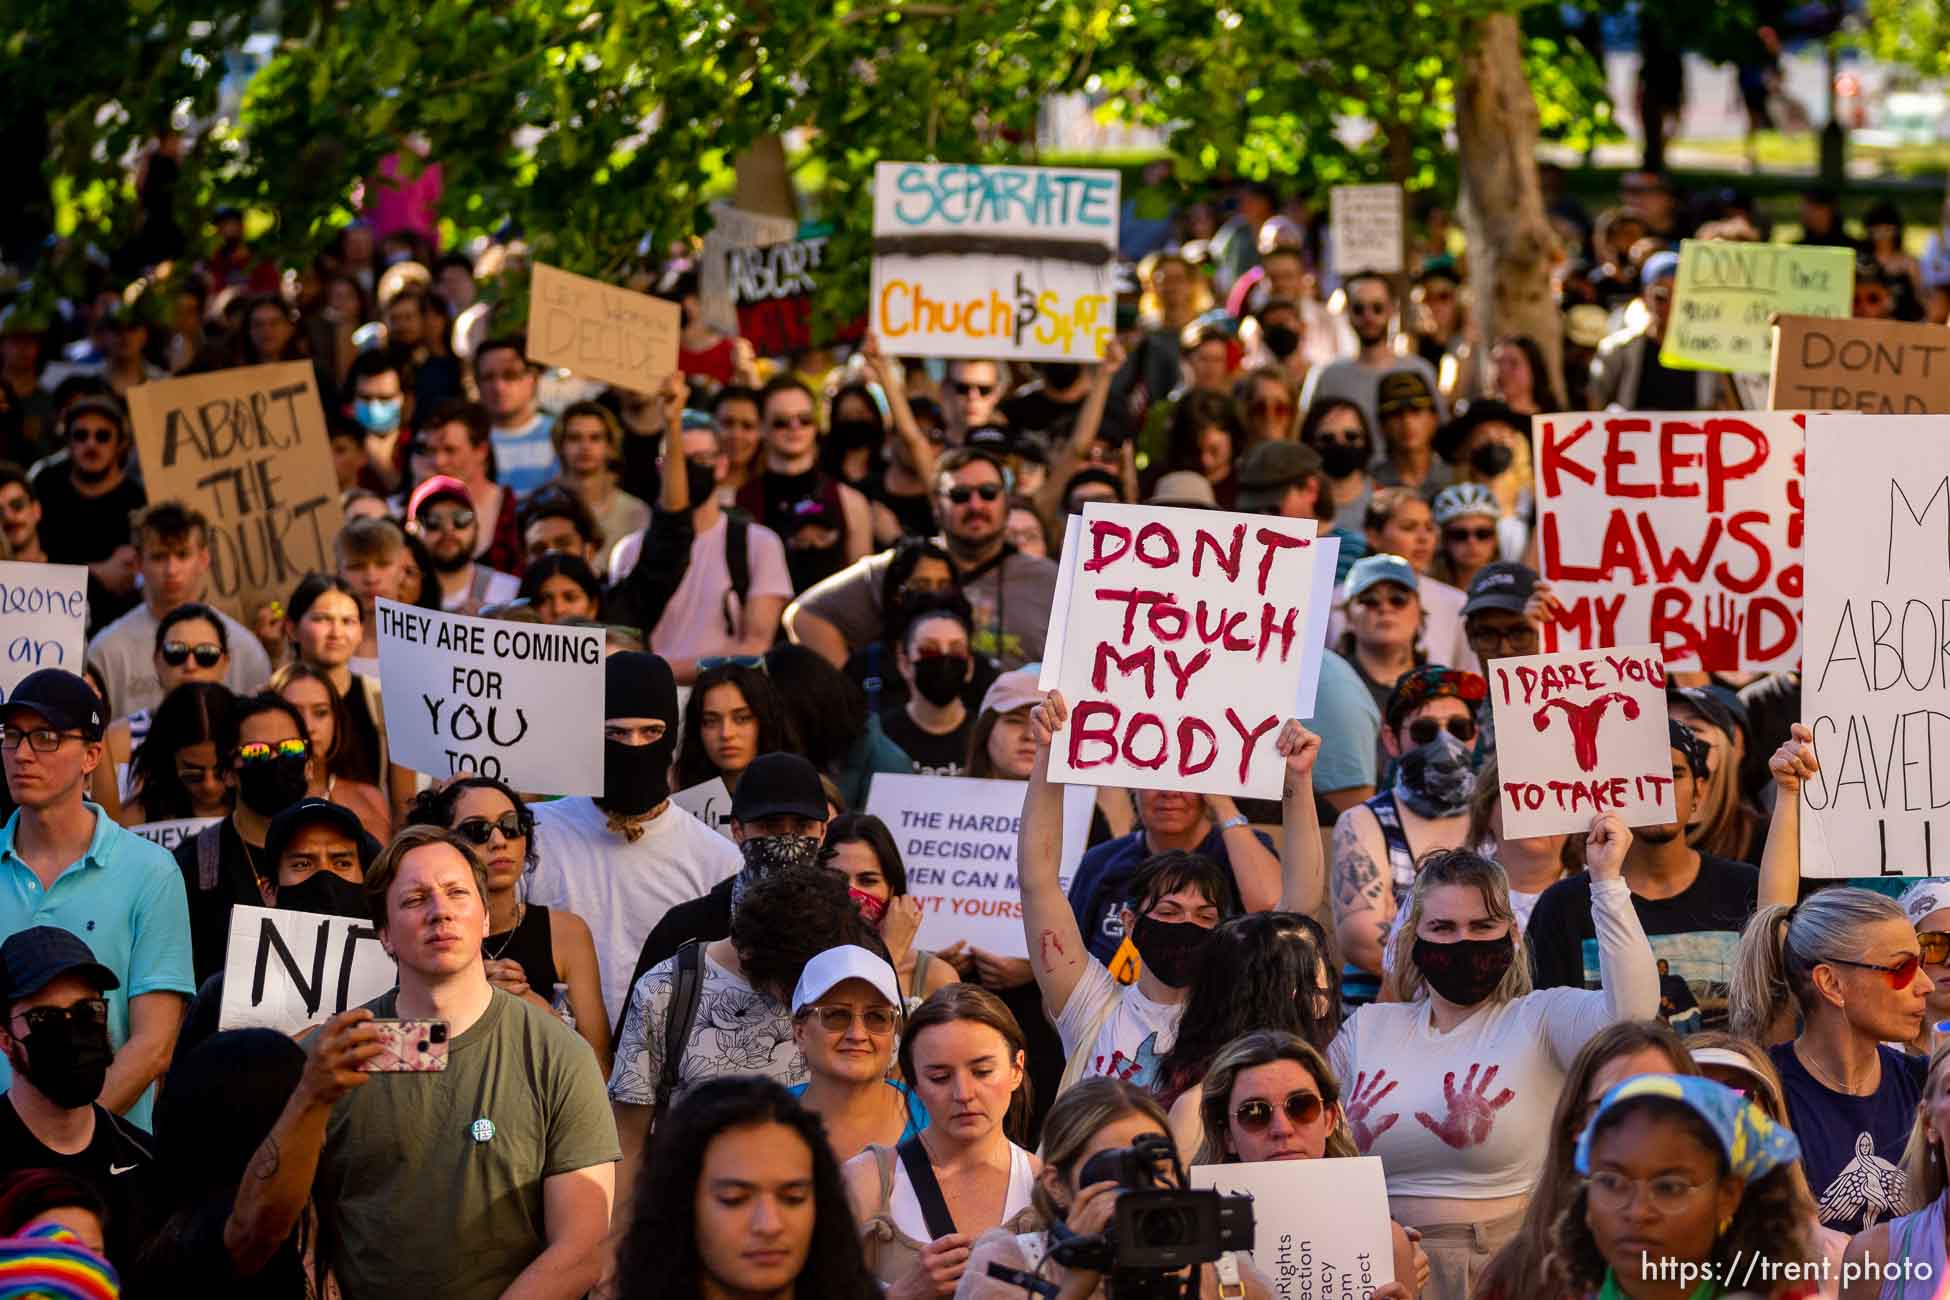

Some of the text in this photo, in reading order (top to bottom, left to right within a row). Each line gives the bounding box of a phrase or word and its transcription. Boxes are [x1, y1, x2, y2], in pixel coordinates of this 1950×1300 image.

[896, 164, 1114, 225] SEPARATE
[1802, 331, 1946, 379] DONT
[162, 382, 308, 468] ABORT
[197, 456, 283, 518] THE
[1541, 418, 1770, 513] KEEP
[201, 496, 329, 599] OURT
[1084, 520, 1310, 596] DONT
[1542, 508, 1772, 594] LAWS
[8, 636, 64, 665] an
[380, 607, 600, 665] THEY ARE COMING
[1096, 587, 1299, 663] TOUCH
[1543, 593, 1626, 654] MY
[453, 667, 502, 699] FOR
[1091, 641, 1212, 700] MY
[1497, 655, 1665, 705] I DARE YOU
[423, 694, 528, 747] YOU
[1067, 700, 1280, 785] BODY
[901, 809, 943, 829] THE
[1503, 774, 1673, 813] TO TAKE IT
[138, 827, 190, 847] HEY
[908, 838, 1012, 861] DECISION
[952, 869, 999, 888] CAN
[952, 895, 1023, 919] YOURS
